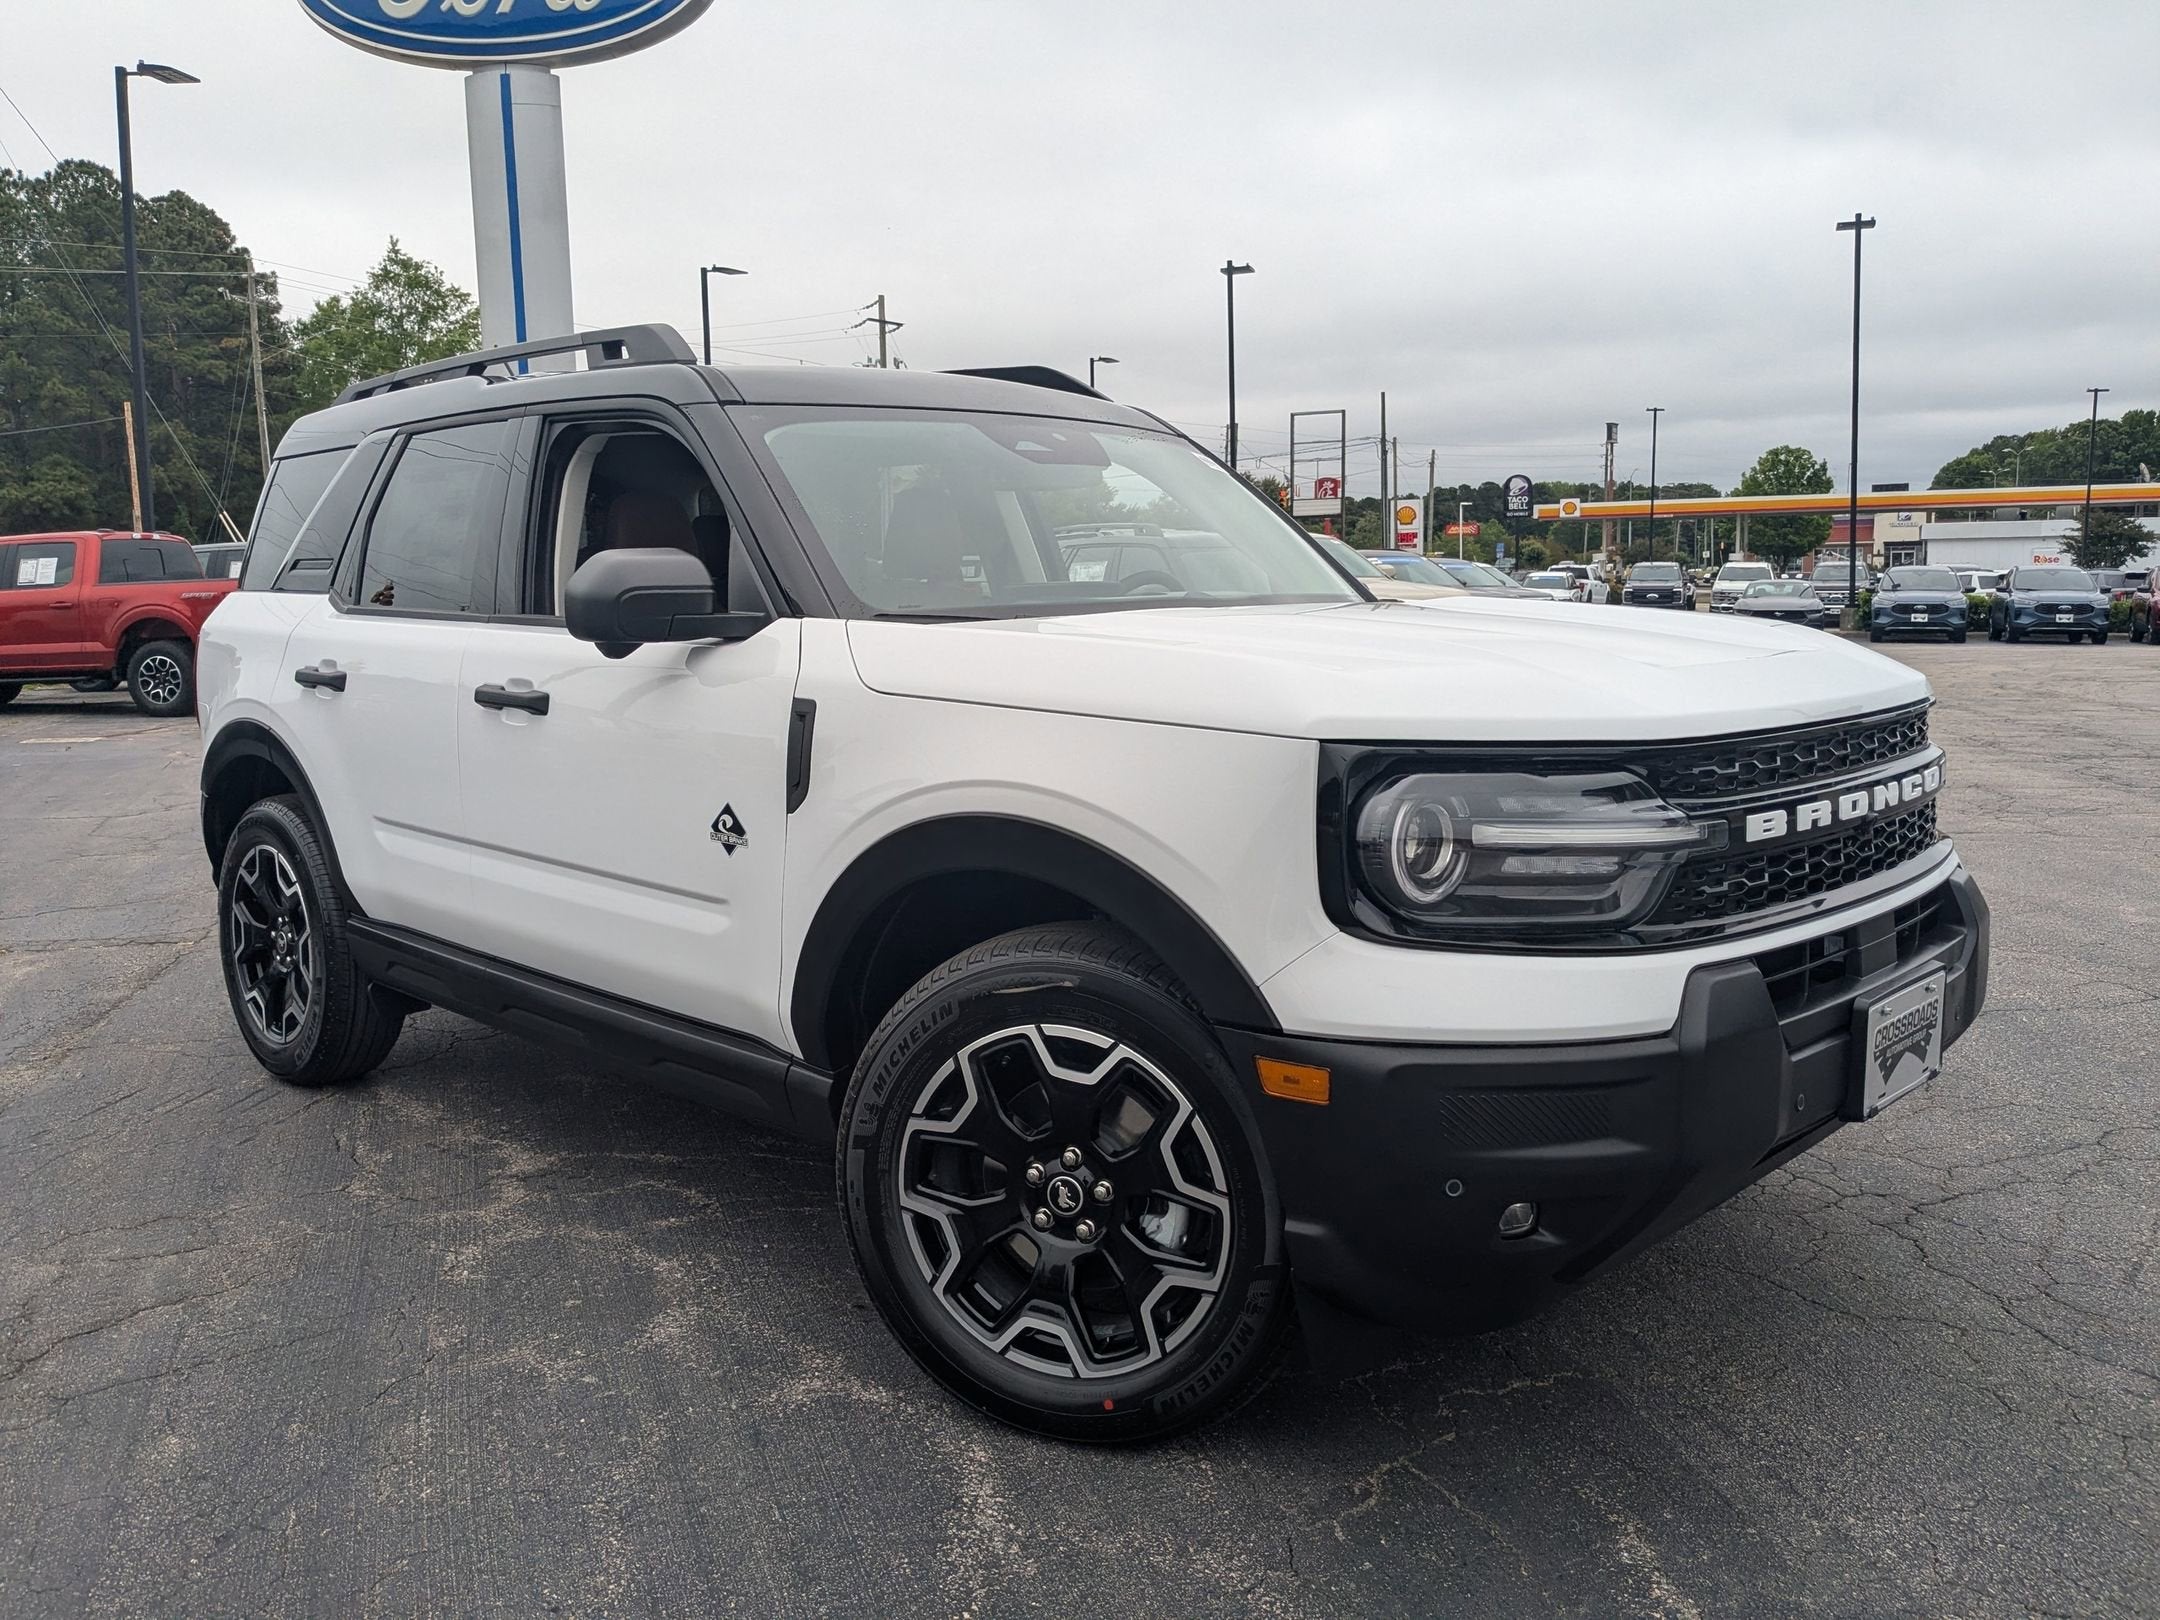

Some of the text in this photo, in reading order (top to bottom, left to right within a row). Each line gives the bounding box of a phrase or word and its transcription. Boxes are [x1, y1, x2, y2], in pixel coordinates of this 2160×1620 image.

[2033, 555, 2060, 564] Rose
[1746, 765, 1941, 843] BRONCO
[872, 1000, 954, 1098] MICHELIN
[1874, 998, 1939, 1050] CROSSROADS
[1161, 1322, 1256, 1412] MICHELIN
